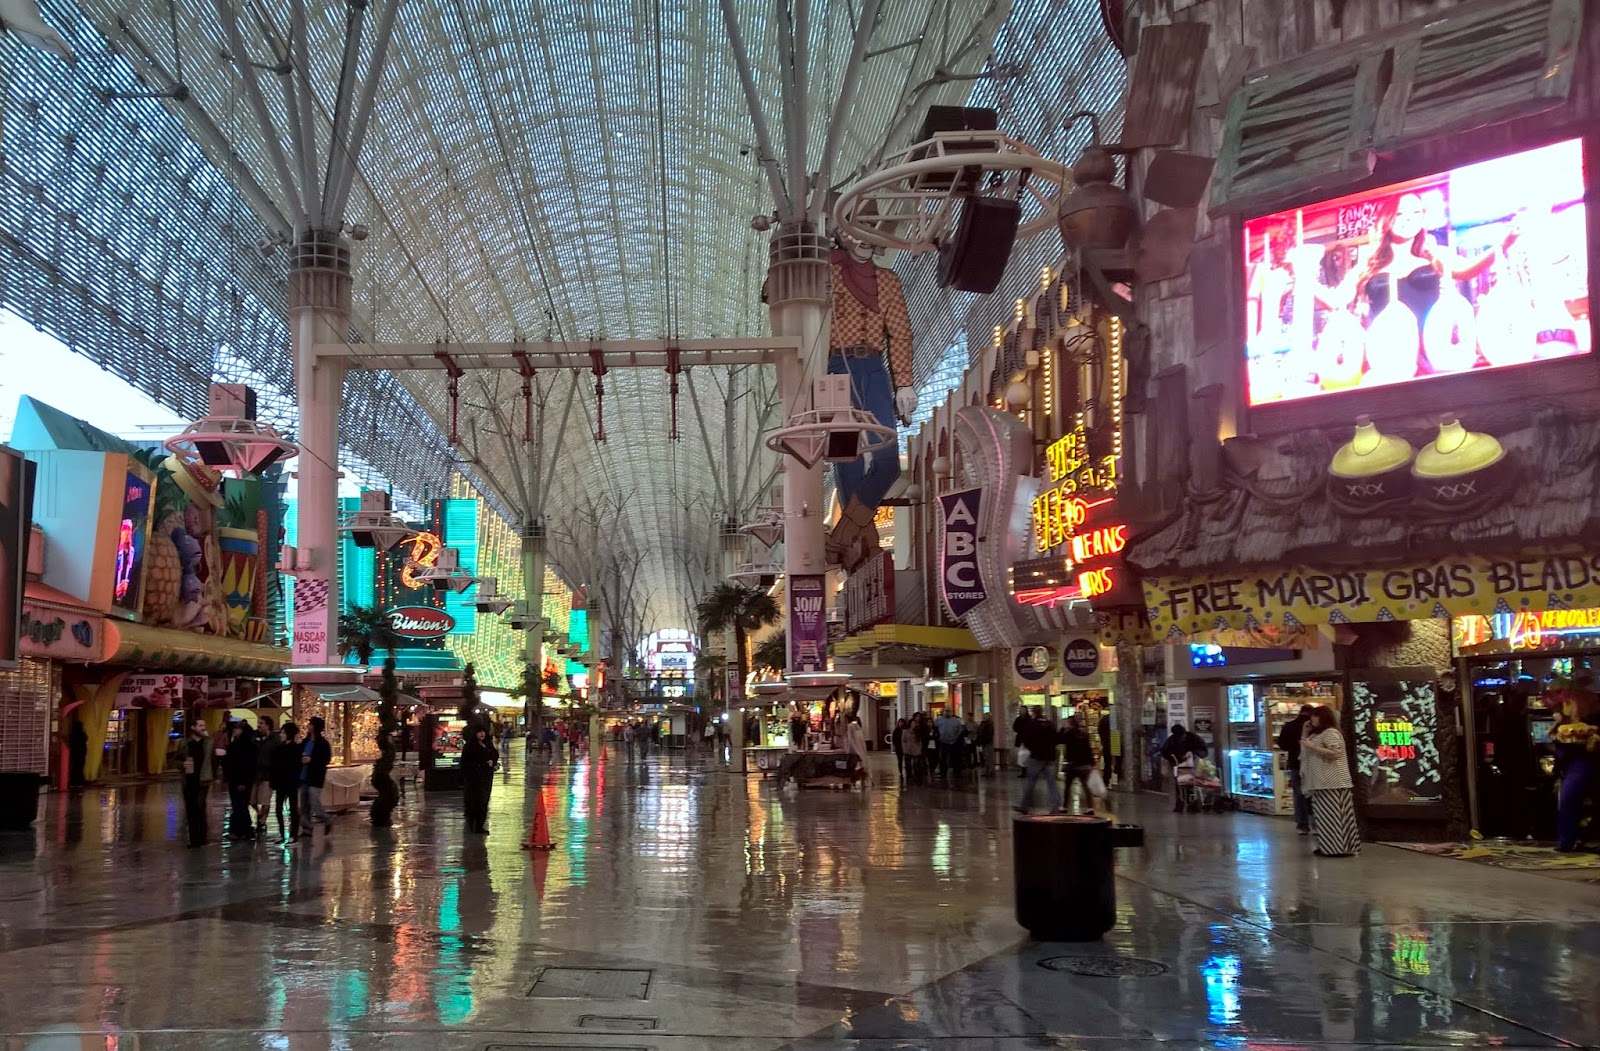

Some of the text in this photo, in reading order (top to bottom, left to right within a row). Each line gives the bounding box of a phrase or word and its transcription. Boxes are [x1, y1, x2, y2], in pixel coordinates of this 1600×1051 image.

[1338, 202, 1377, 224] FANCY
[1337, 216, 1377, 235] BEADS
[946, 497, 976, 588] ABC
[947, 592, 985, 600] STORES
[1168, 579, 1243, 620] FREE
[1255, 571, 1371, 607] MARDI
[1382, 564, 1476, 601] GRAS
[793, 596, 823, 612] JOIN
[388, 612, 451, 631] Binion's
[797, 612, 819, 623] THE
[293, 631, 326, 642] NASCAR
[299, 643, 320, 654] FANS
[1067, 648, 1097, 661] ABC
[1379, 731, 1412, 746] FREE
